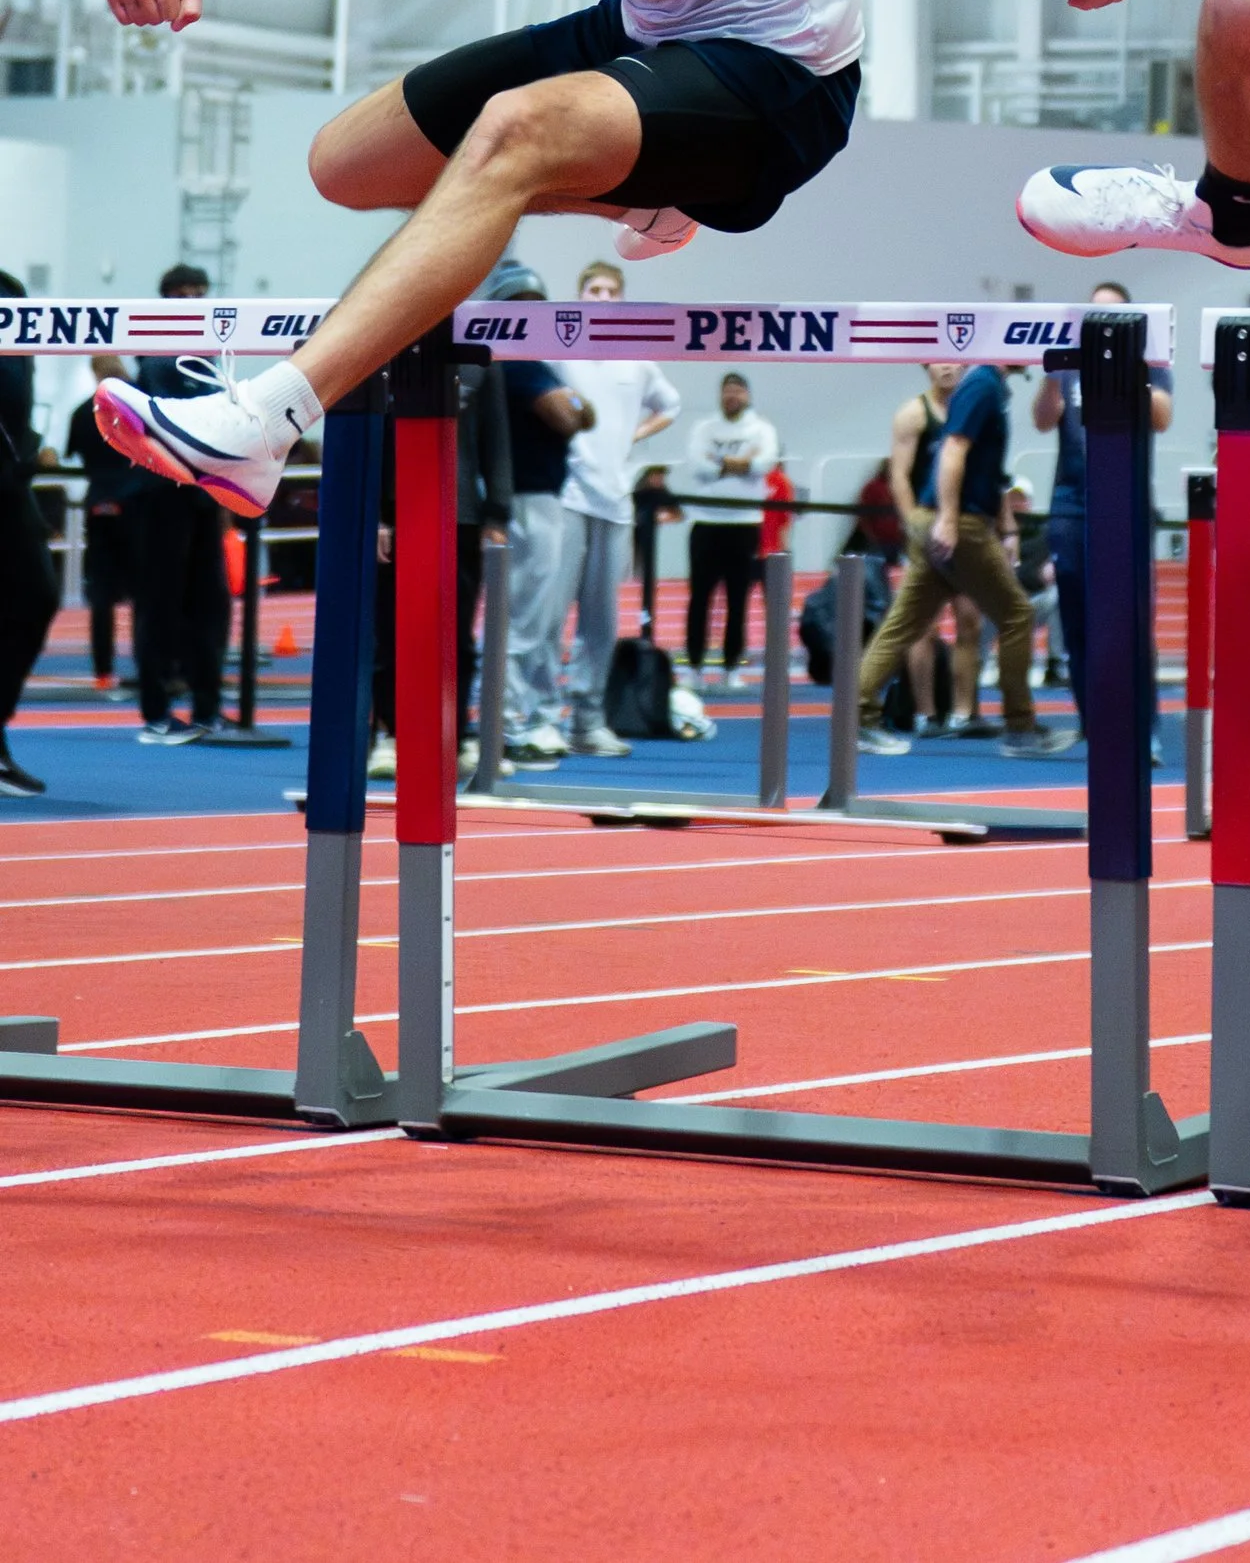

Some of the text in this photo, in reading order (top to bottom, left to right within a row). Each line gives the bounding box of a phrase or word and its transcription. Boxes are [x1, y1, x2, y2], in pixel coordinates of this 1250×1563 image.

[463, 310, 1073, 352] GILL PENN GILL
